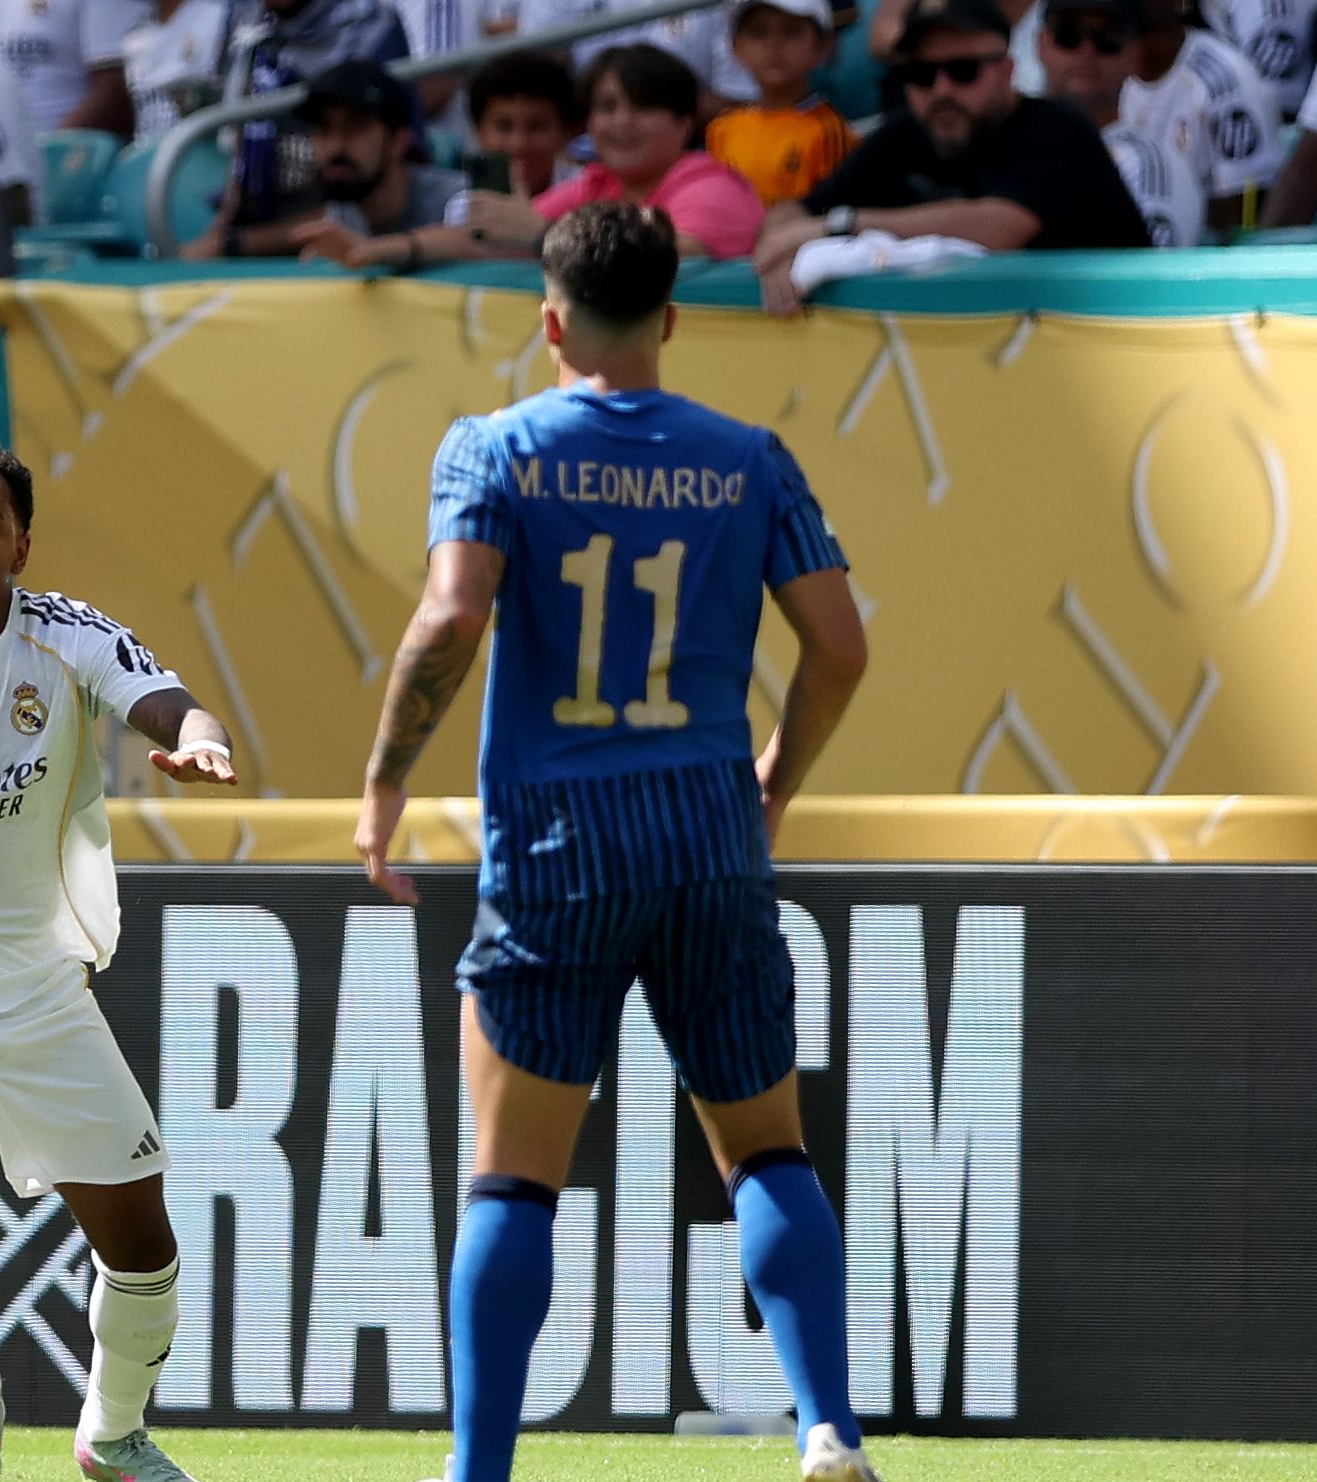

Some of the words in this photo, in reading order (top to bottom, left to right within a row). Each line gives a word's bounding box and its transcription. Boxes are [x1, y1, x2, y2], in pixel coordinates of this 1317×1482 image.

[512, 456, 550, 498] M.
[557, 460, 746, 509] LEONARDO
[552, 532, 691, 729] 11
